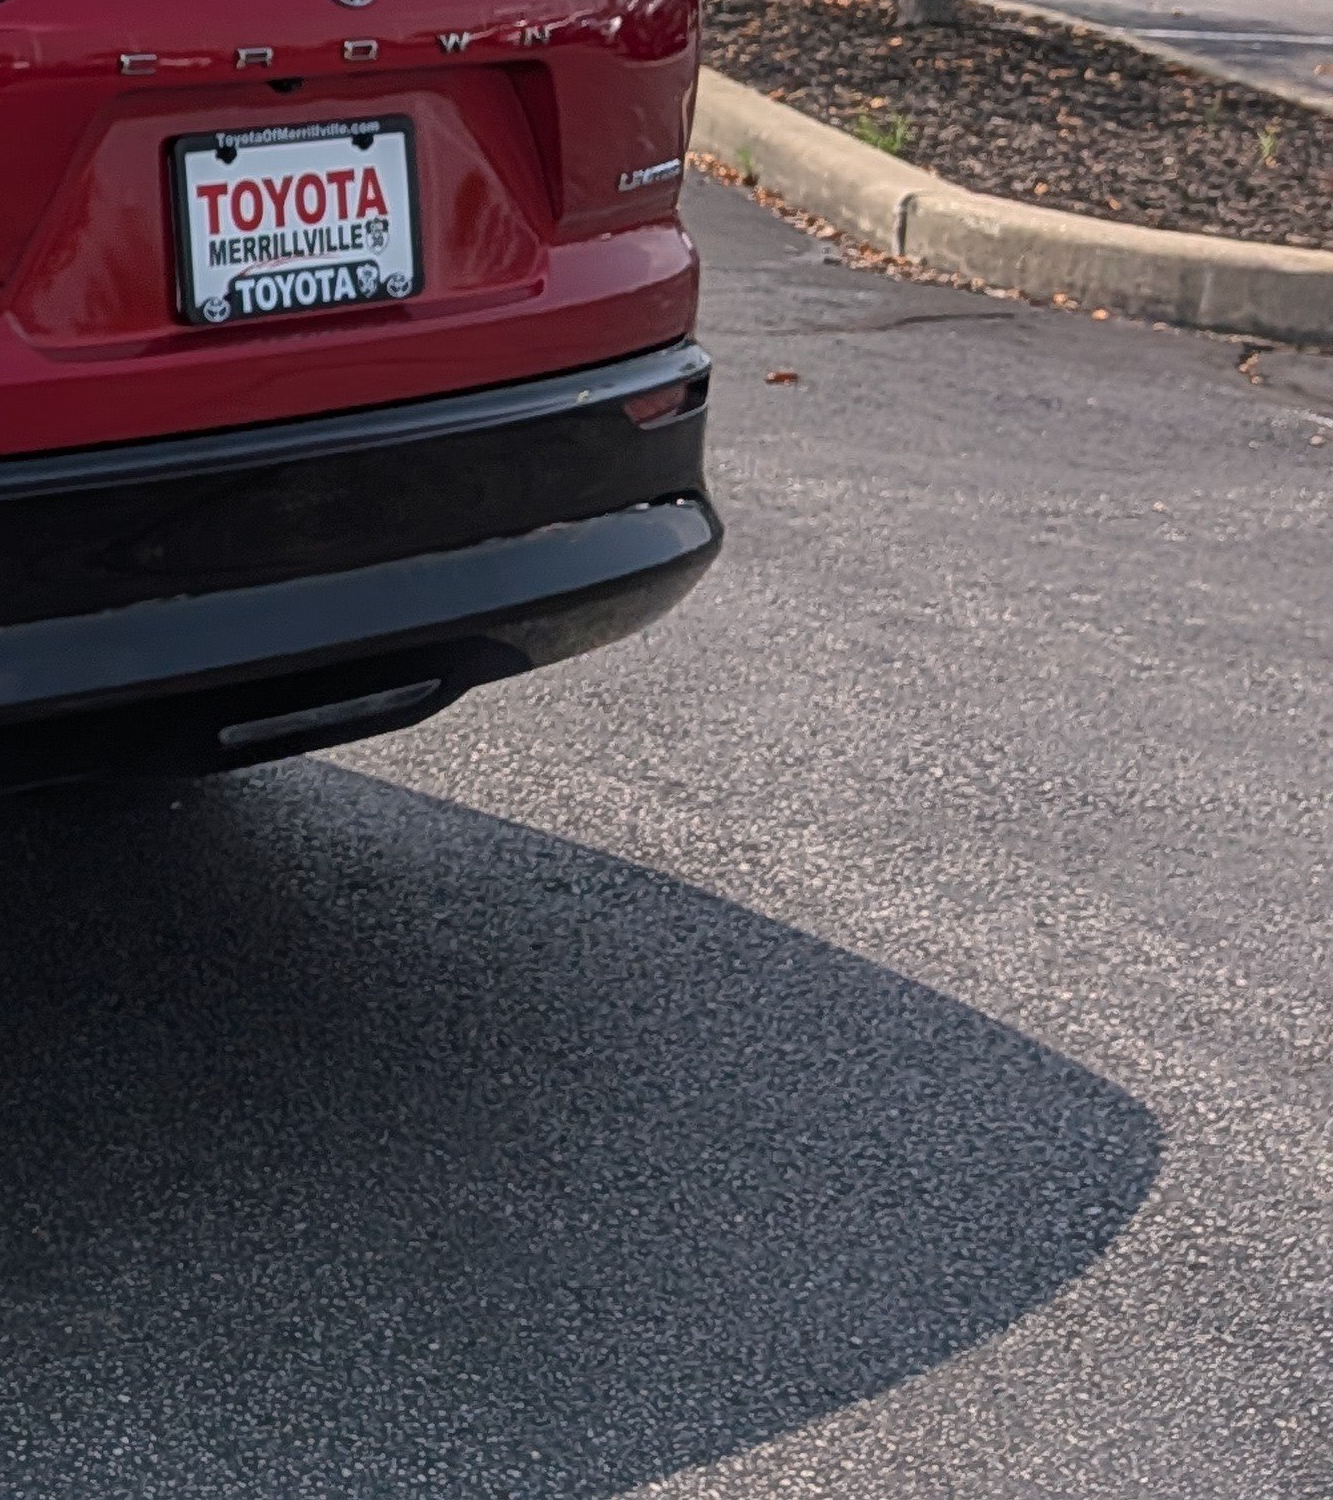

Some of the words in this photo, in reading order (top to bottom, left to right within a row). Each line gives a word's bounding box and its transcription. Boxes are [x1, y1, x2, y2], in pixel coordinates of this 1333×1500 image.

[119, 25, 551, 76] CROWN
[197, 167, 388, 234] TOYOTA
[209, 224, 363, 267] MERRILLVILLE
[236, 267, 357, 313] TOYOTA
